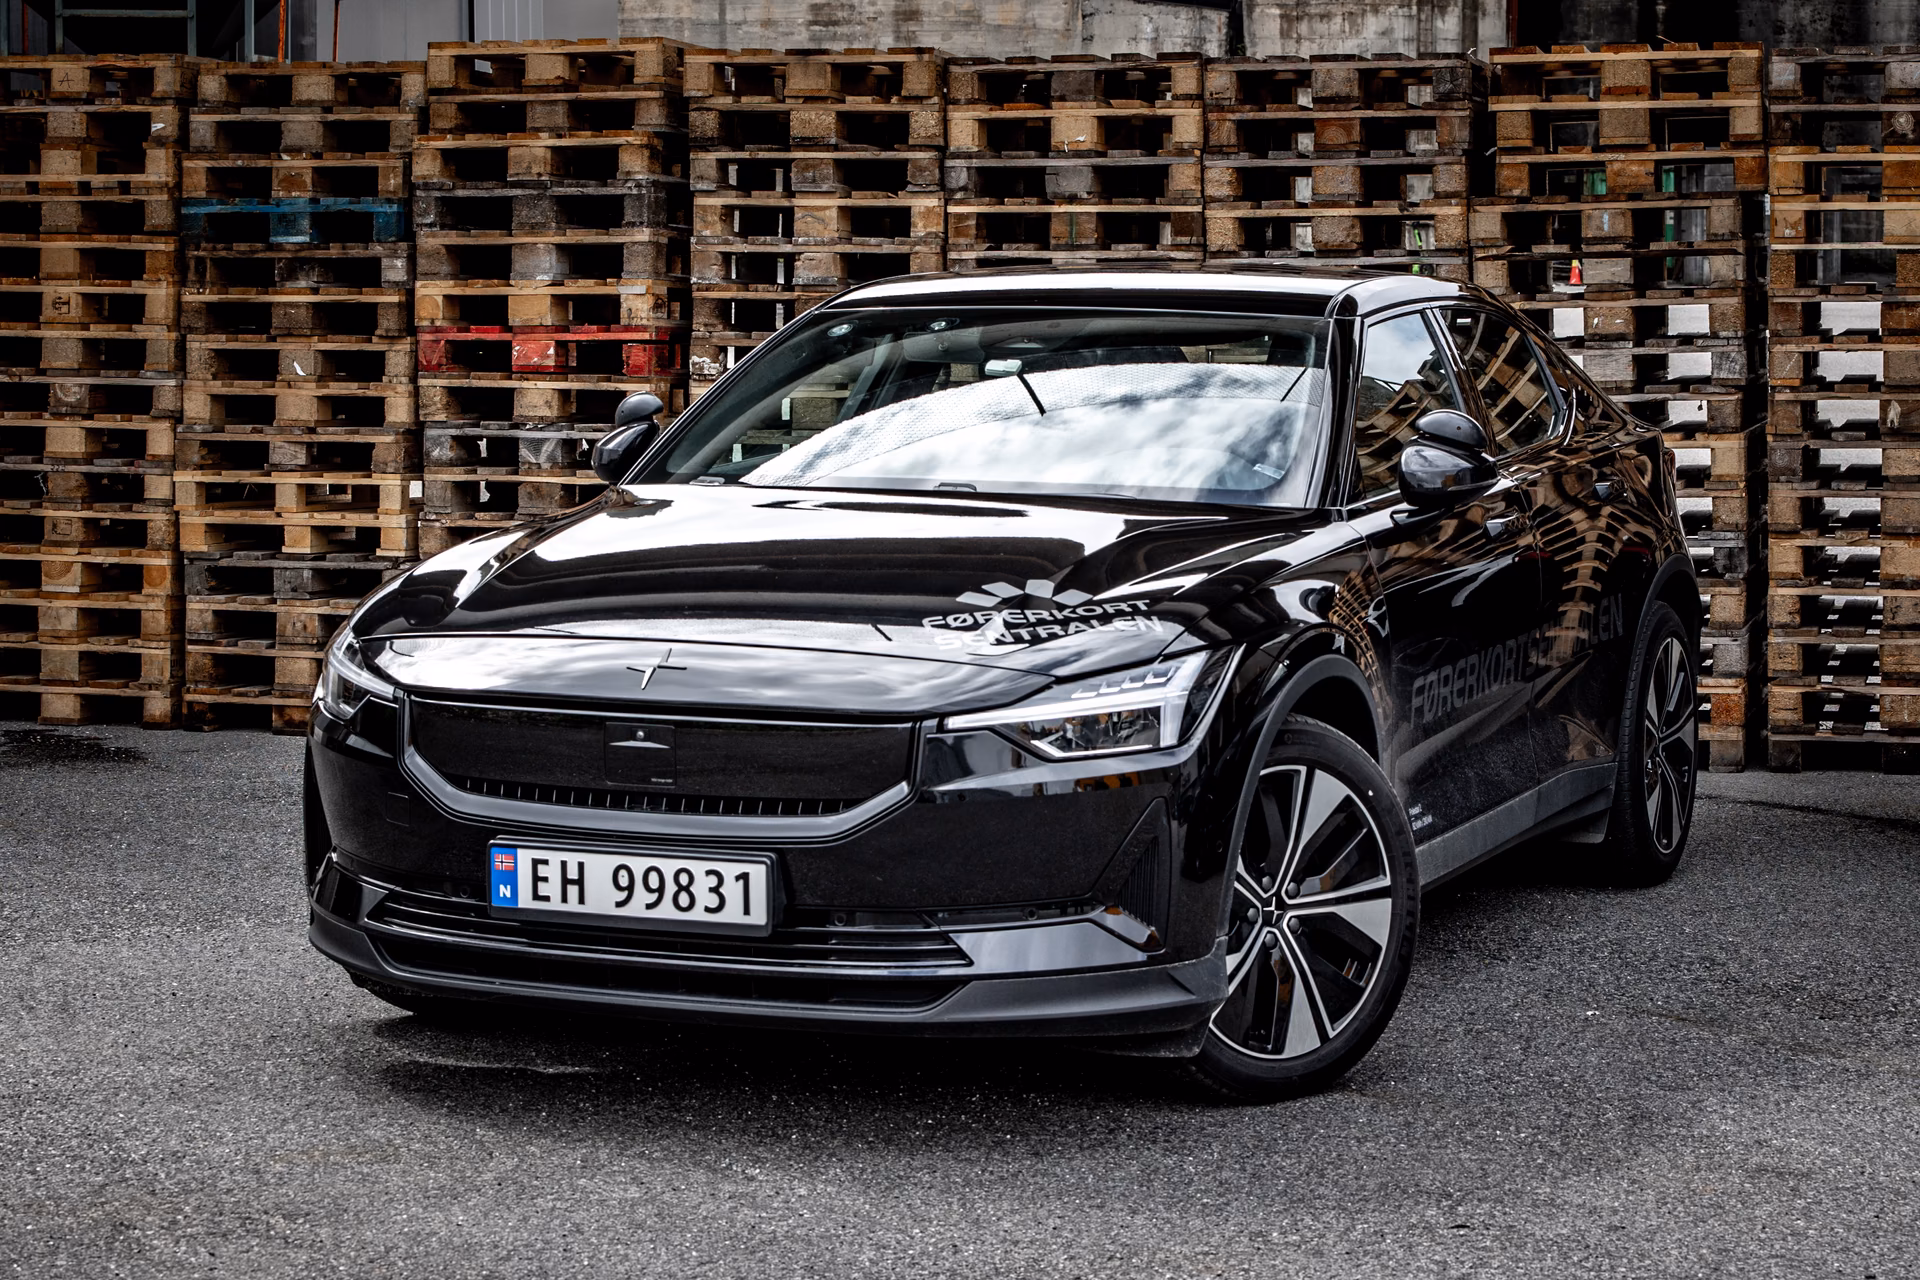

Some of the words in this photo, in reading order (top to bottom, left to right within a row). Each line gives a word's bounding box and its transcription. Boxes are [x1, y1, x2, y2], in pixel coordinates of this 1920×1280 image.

[921, 599, 1150, 630] FØRERKORT
[934, 615, 1164, 650] SENTRALEN
[499, 884, 511, 899] N
[531, 857, 586, 906] EH
[612, 862, 752, 917] 99831
